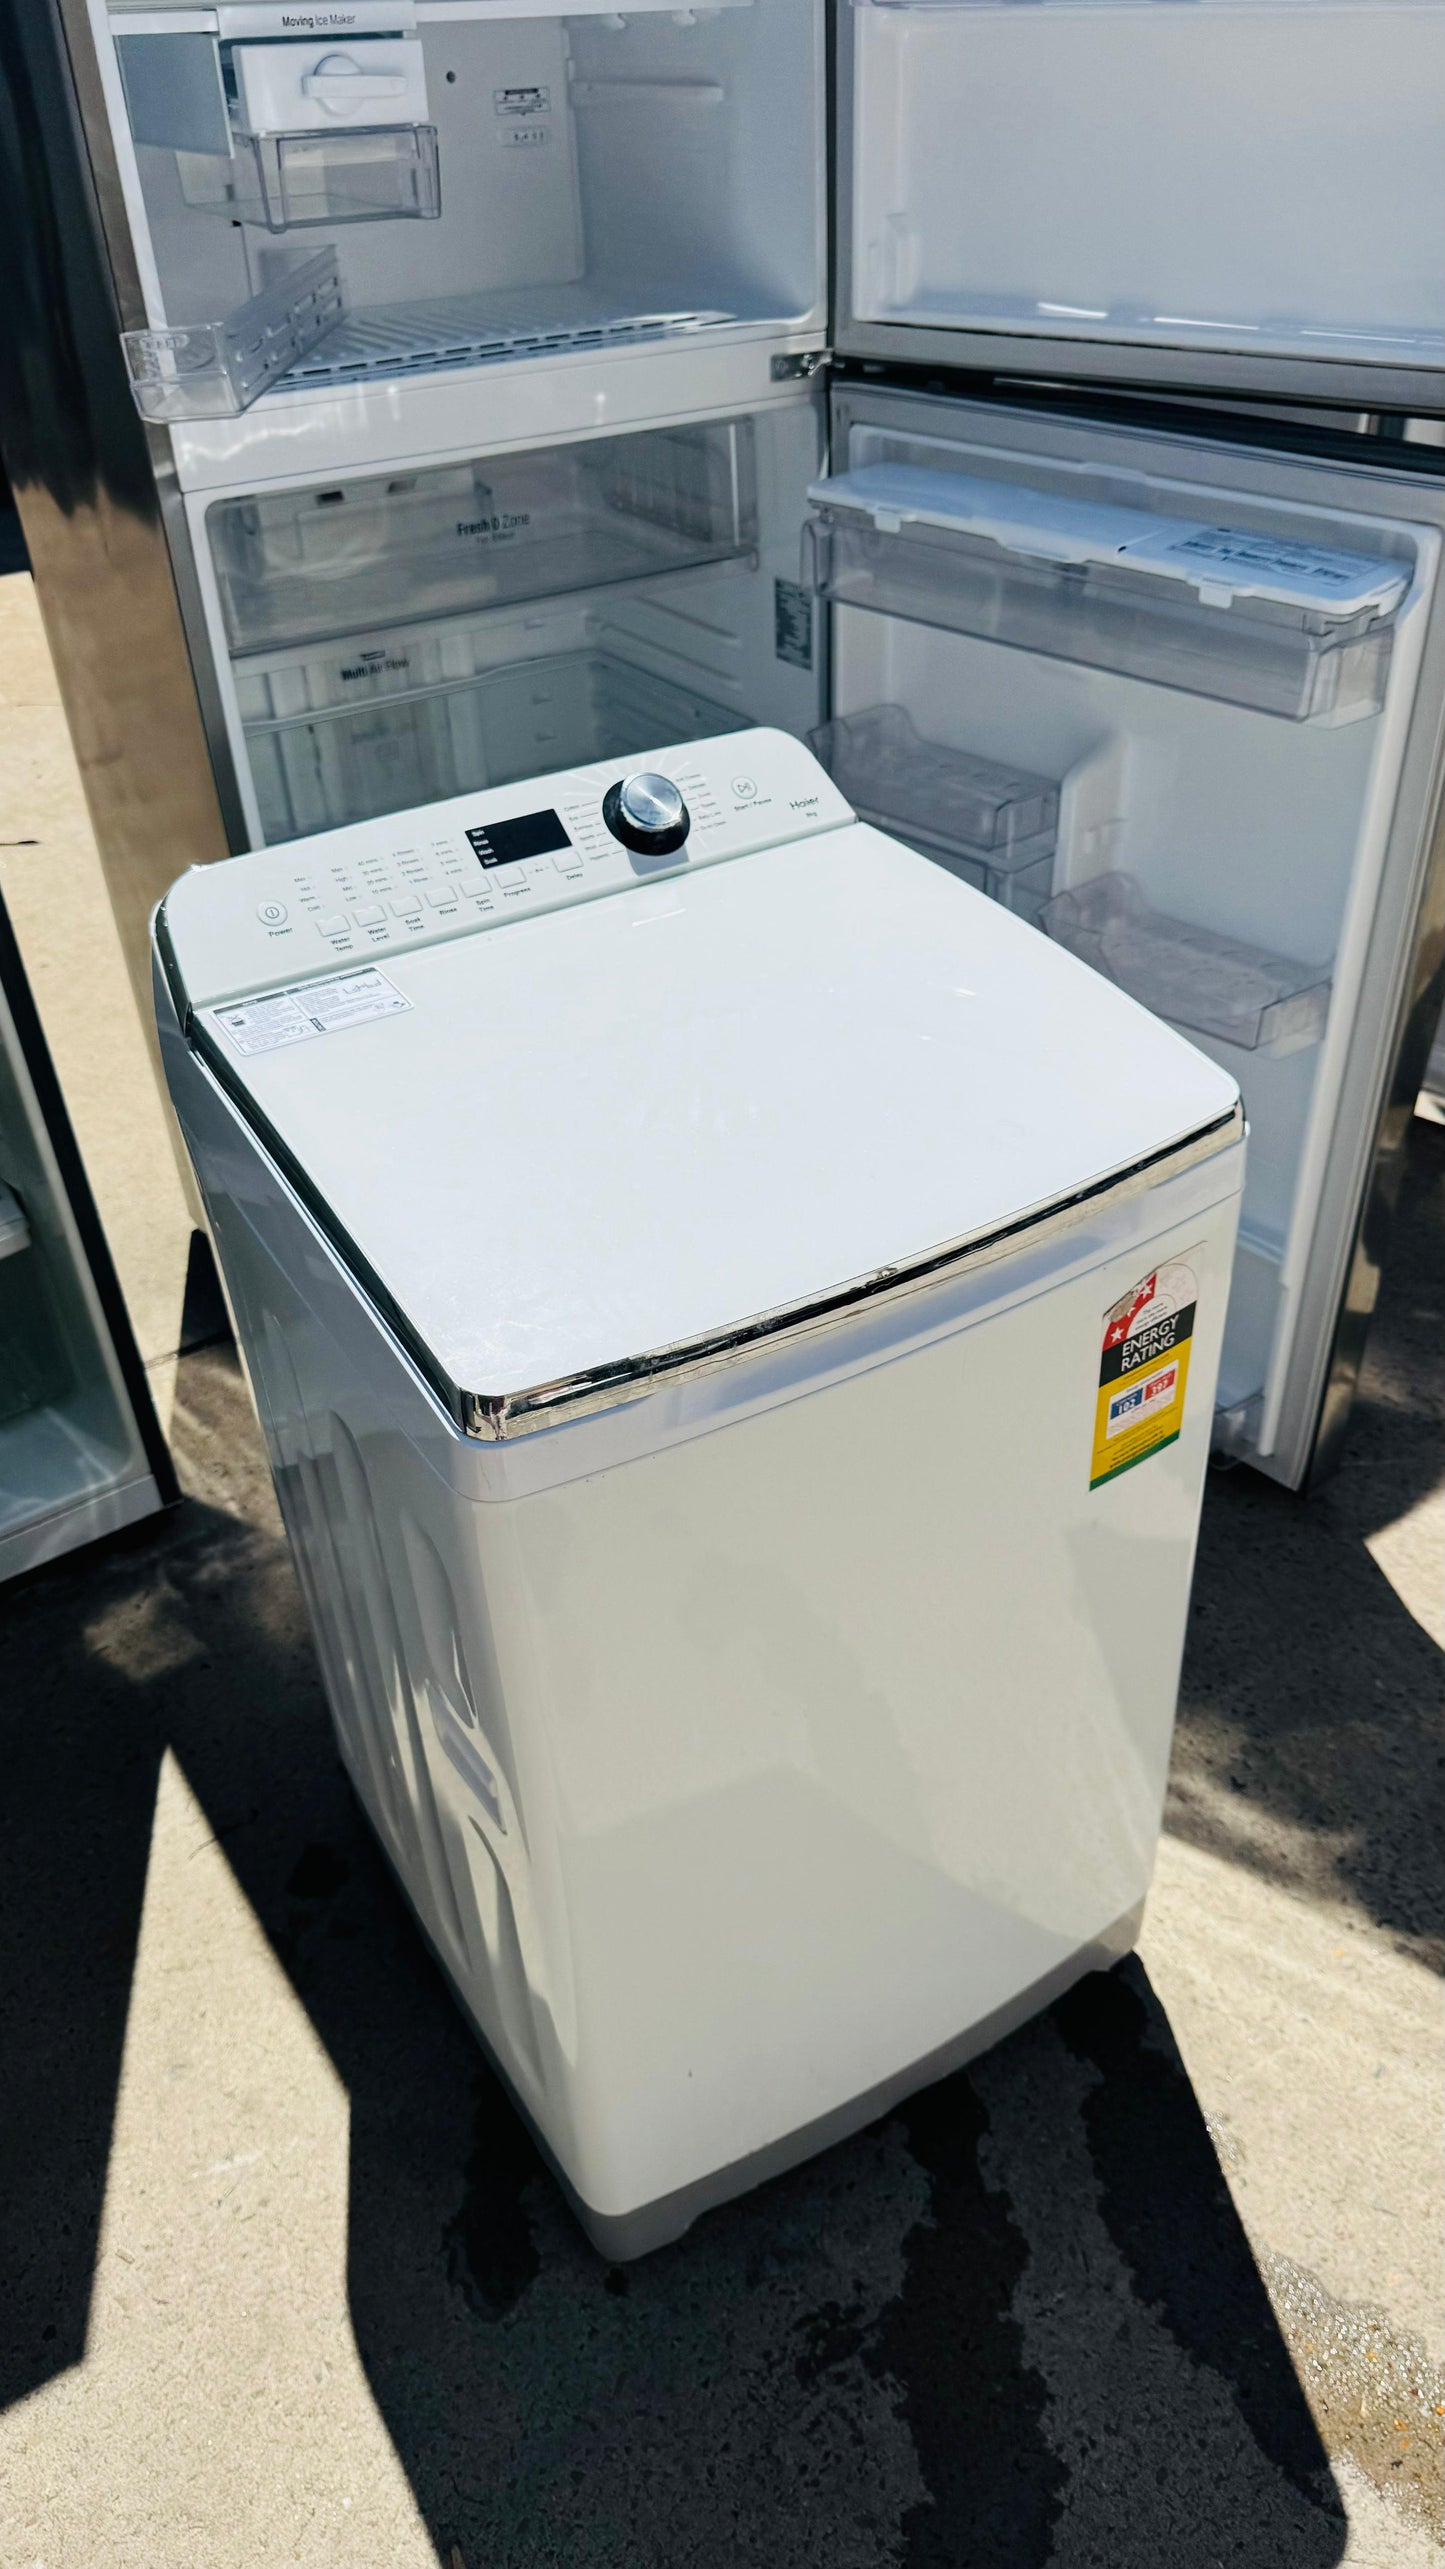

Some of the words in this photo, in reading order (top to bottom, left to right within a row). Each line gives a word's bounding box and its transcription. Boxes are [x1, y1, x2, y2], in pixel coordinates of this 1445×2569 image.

[282, 15, 314, 28] Moving
[315, 15, 329, 26] Ice
[329, 14, 356, 25] Maker
[457, 518, 491, 536] Fresh
[502, 513, 530, 529] Zone
[733, 803, 749, 812] Start
[753, 797, 772, 807] Pause
[789, 796, 819, 811] Haier
[566, 872, 583, 881] Delay
[475, 898, 490, 907] Spin
[439, 907, 458, 915] Rinse
[478, 905, 494, 913] Time
[404, 917, 421, 925] Soak
[268, 927, 293, 937] Power
[367, 927, 387, 935] Water
[408, 924, 425, 932] Time
[330, 937, 350, 945] Water
[371, 933, 390, 943] Level
[335, 944, 354, 952] Temp
[1122, 1313, 1180, 1357] ENERGY
[1121, 1331, 1176, 1372] RATING
